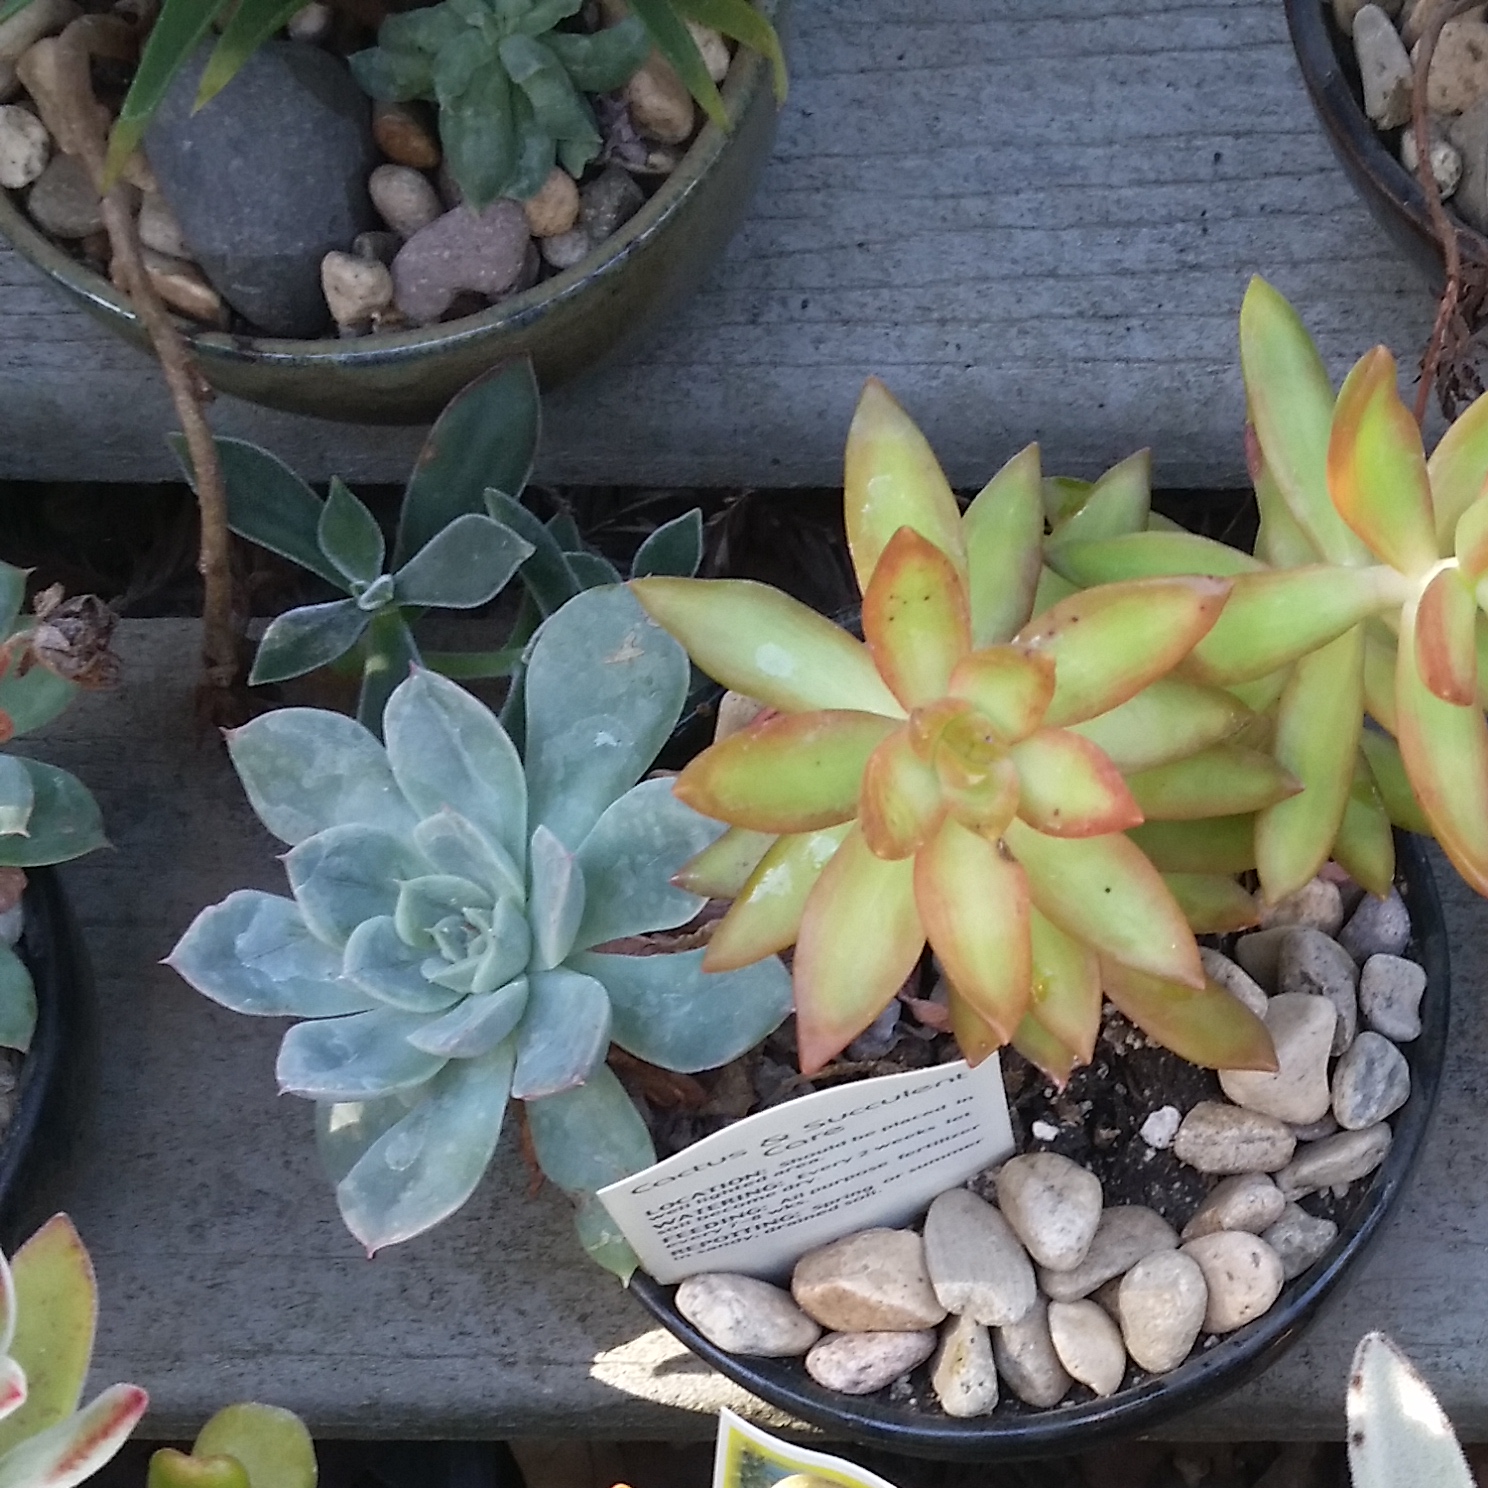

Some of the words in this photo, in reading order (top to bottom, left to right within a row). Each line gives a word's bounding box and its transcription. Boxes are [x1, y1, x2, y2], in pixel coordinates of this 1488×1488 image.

[632, 1150, 748, 1194] Cactus
[761, 1134, 789, 1147] &
[803, 1072, 968, 1129] Succulent
[646, 1169, 767, 1215] LOCATION:
[882, 1104, 946, 1131] placed
[763, 1126, 845, 1156] Care
[649, 1203, 691, 1221] well
[697, 1176, 767, 1203] lighted
[653, 1181, 784, 1228] WATERING:
[875, 1126, 935, 1151] weeks
[663, 1205, 767, 1243] FEEDING:
[810, 1161, 888, 1195] purpose
[697, 1191, 777, 1221] become
[671, 1211, 800, 1255] REPOTTING:
